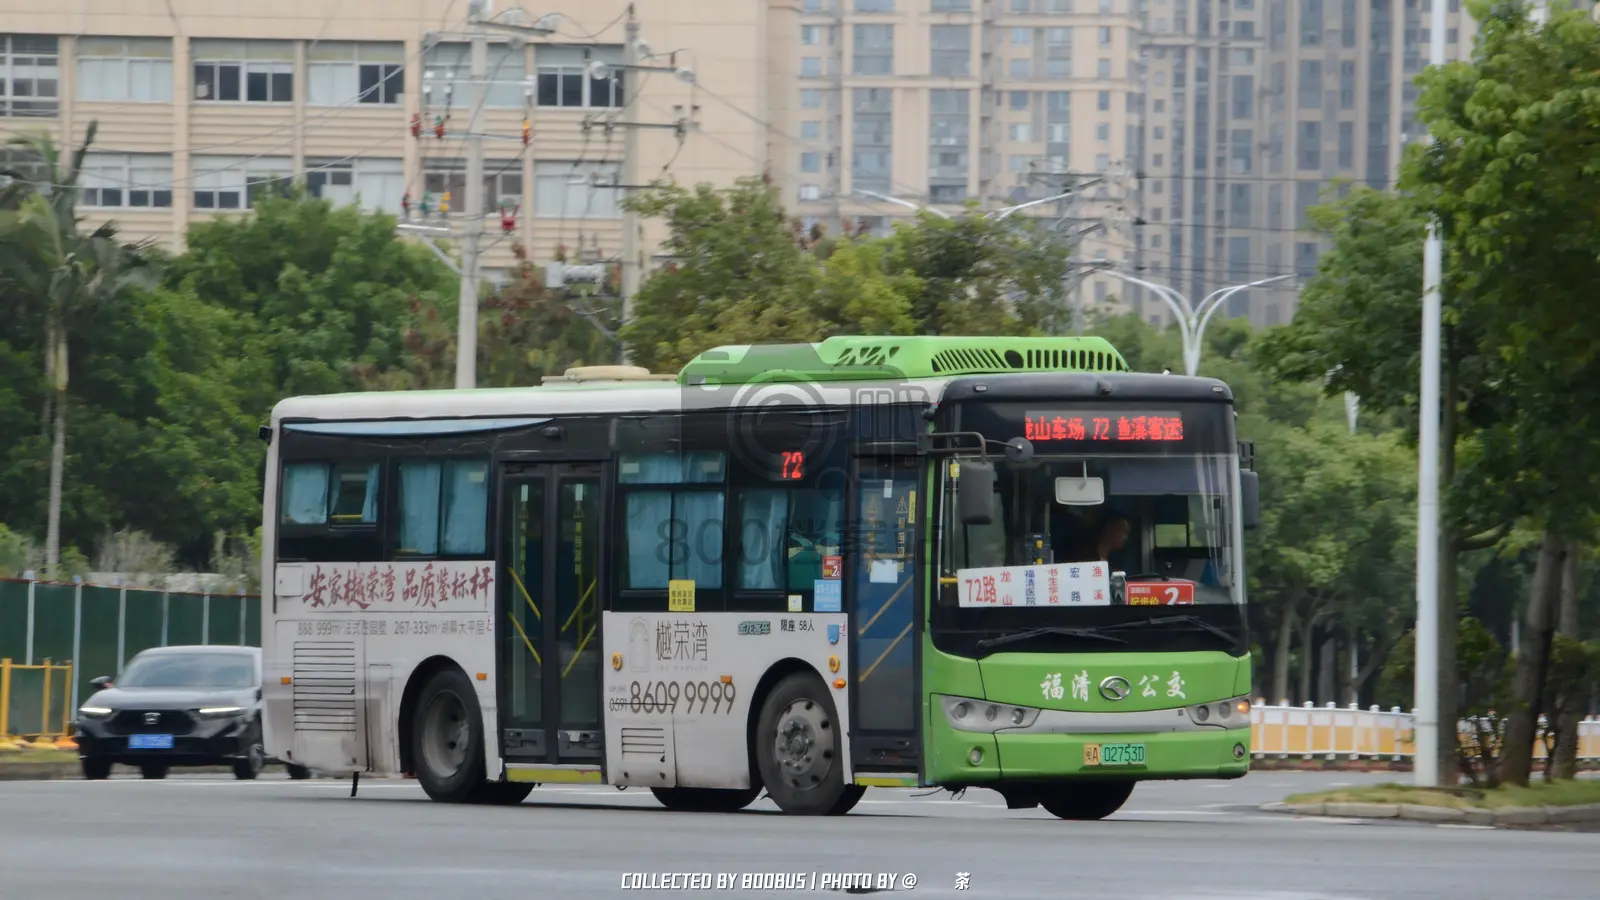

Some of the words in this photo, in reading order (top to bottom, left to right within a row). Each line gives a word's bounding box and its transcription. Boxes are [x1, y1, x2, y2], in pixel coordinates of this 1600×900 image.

[1093, 418, 1110, 440] 72
[781, 451, 804, 479] 72
[965, 576, 997, 604] 72路
[1025, 569, 1036, 606] 福清医院
[1048, 568, 1059, 604] 书生学校
[1070, 567, 1081, 602] 宏路
[1092, 565, 1104, 601] 渔溪
[780, 619, 795, 632] 限座
[799, 618, 815, 632] 58人
[630, 680, 680, 714] 8609
[684, 680, 736, 715] 9999
[1040, 669, 1091, 702] 福清
[1138, 670, 1186, 700] 公交
